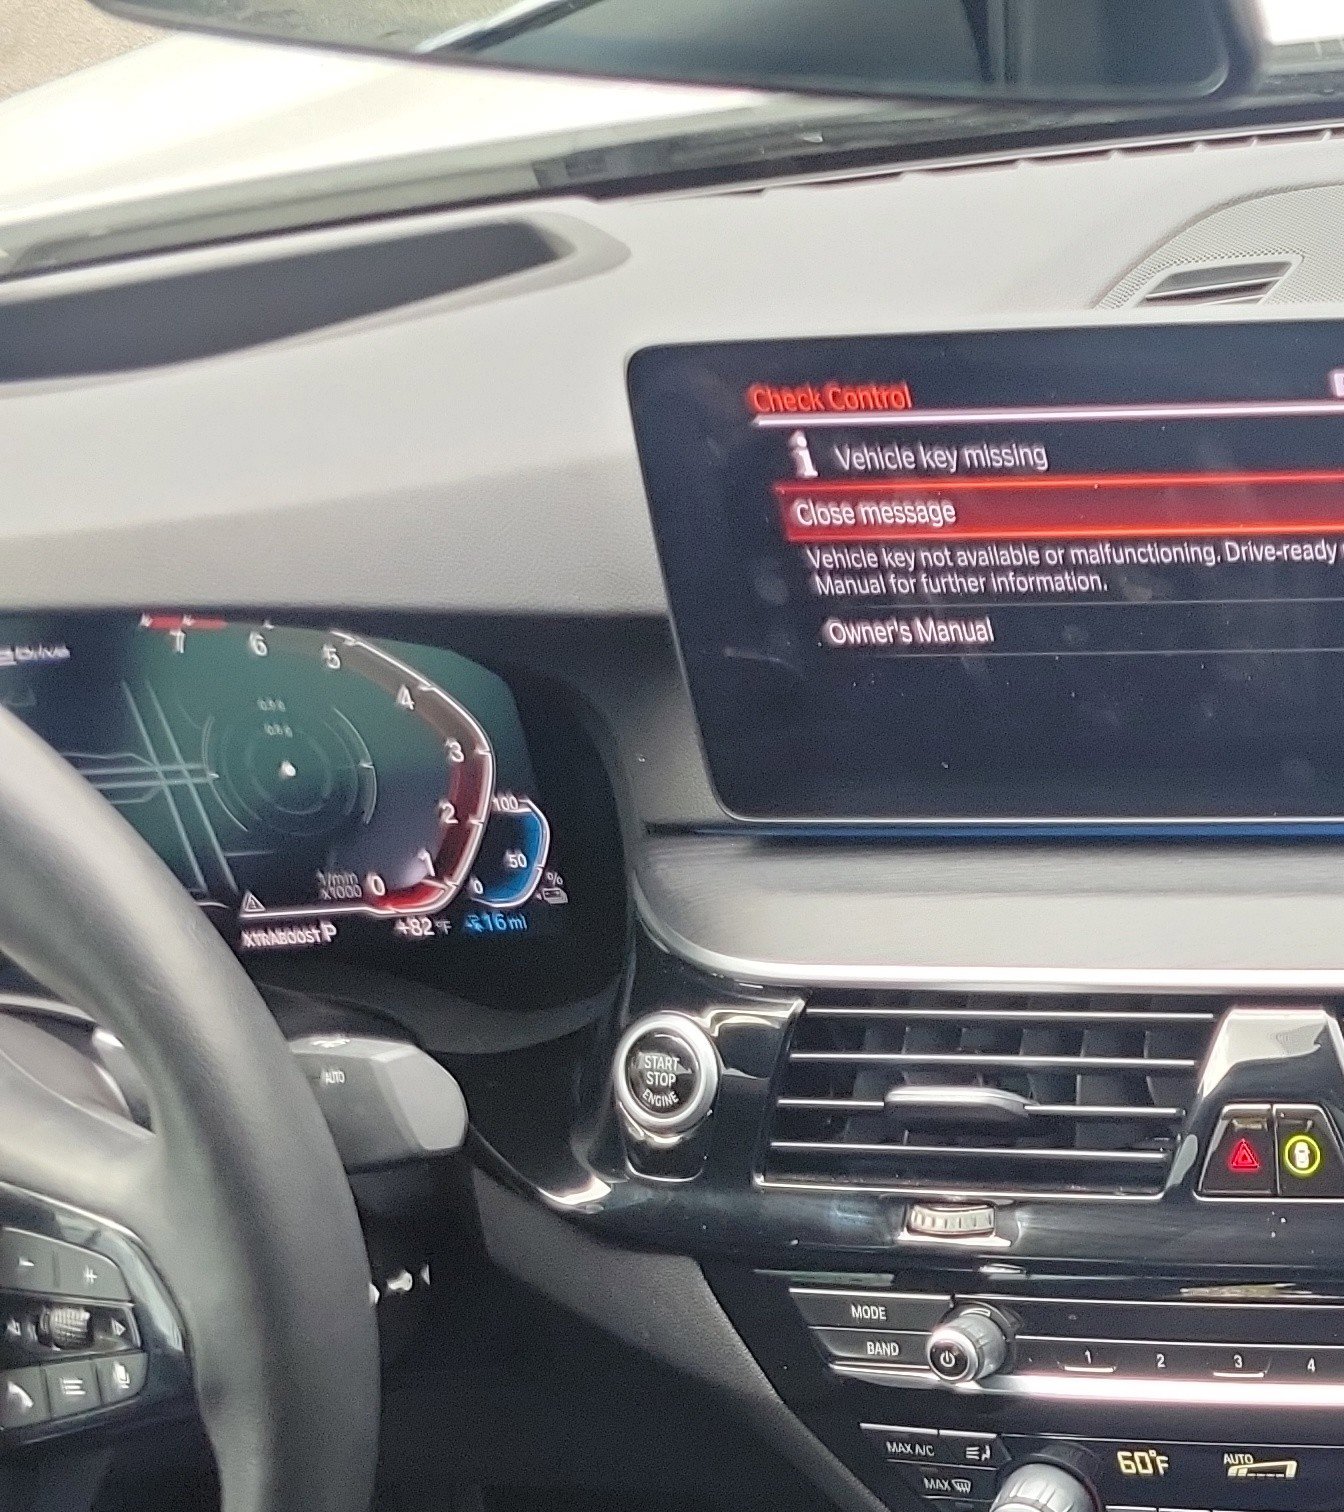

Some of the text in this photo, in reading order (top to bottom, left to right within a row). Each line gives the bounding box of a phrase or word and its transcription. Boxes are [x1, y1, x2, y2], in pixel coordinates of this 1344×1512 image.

[752, 381, 913, 413] Check Control
[834, 442, 1049, 473] Vehicle key missing
[796, 501, 956, 528] Close message
[807, 547, 878, 571] Vehicle
[882, 547, 916, 573] key
[920, 549, 953, 569] not
[956, 546, 1040, 569] available
[1044, 550, 1066, 566] or
[1070, 541, 1221, 568] malfunctioning.
[1225, 538, 1337, 564] Drive-ready
[815, 571, 1108, 597] Manual for further information.
[827, 617, 995, 645] Owner's Manual
[249, 630, 268, 657] 6
[322, 643, 341, 670] 5
[398, 683, 415, 710] 4
[446, 737, 464, 764] 3
[440, 802, 458, 824] 2
[492, 797, 519, 812] 100
[419, 848, 436, 877] 1
[505, 852, 528, 869] 50
[367, 873, 386, 896] 0
[472, 879, 484, 895] 0
[644, 1055, 680, 1072] START
[646, 1071, 677, 1087] STOP
[642, 1088, 680, 1108] ENGINE
[851, 1305, 887, 1321] MODE
[866, 1341, 900, 1356] BAND
[1084, 1349, 1093, 1366] 1
[1156, 1353, 1166, 1369] 2
[1232, 1353, 1243, 1369] 3
[1306, 1357, 1317, 1374] 4
[886, 1441, 914, 1455] MAX
[1223, 1453, 1254, 1466] AUTO
[923, 1477, 951, 1491] MAX
